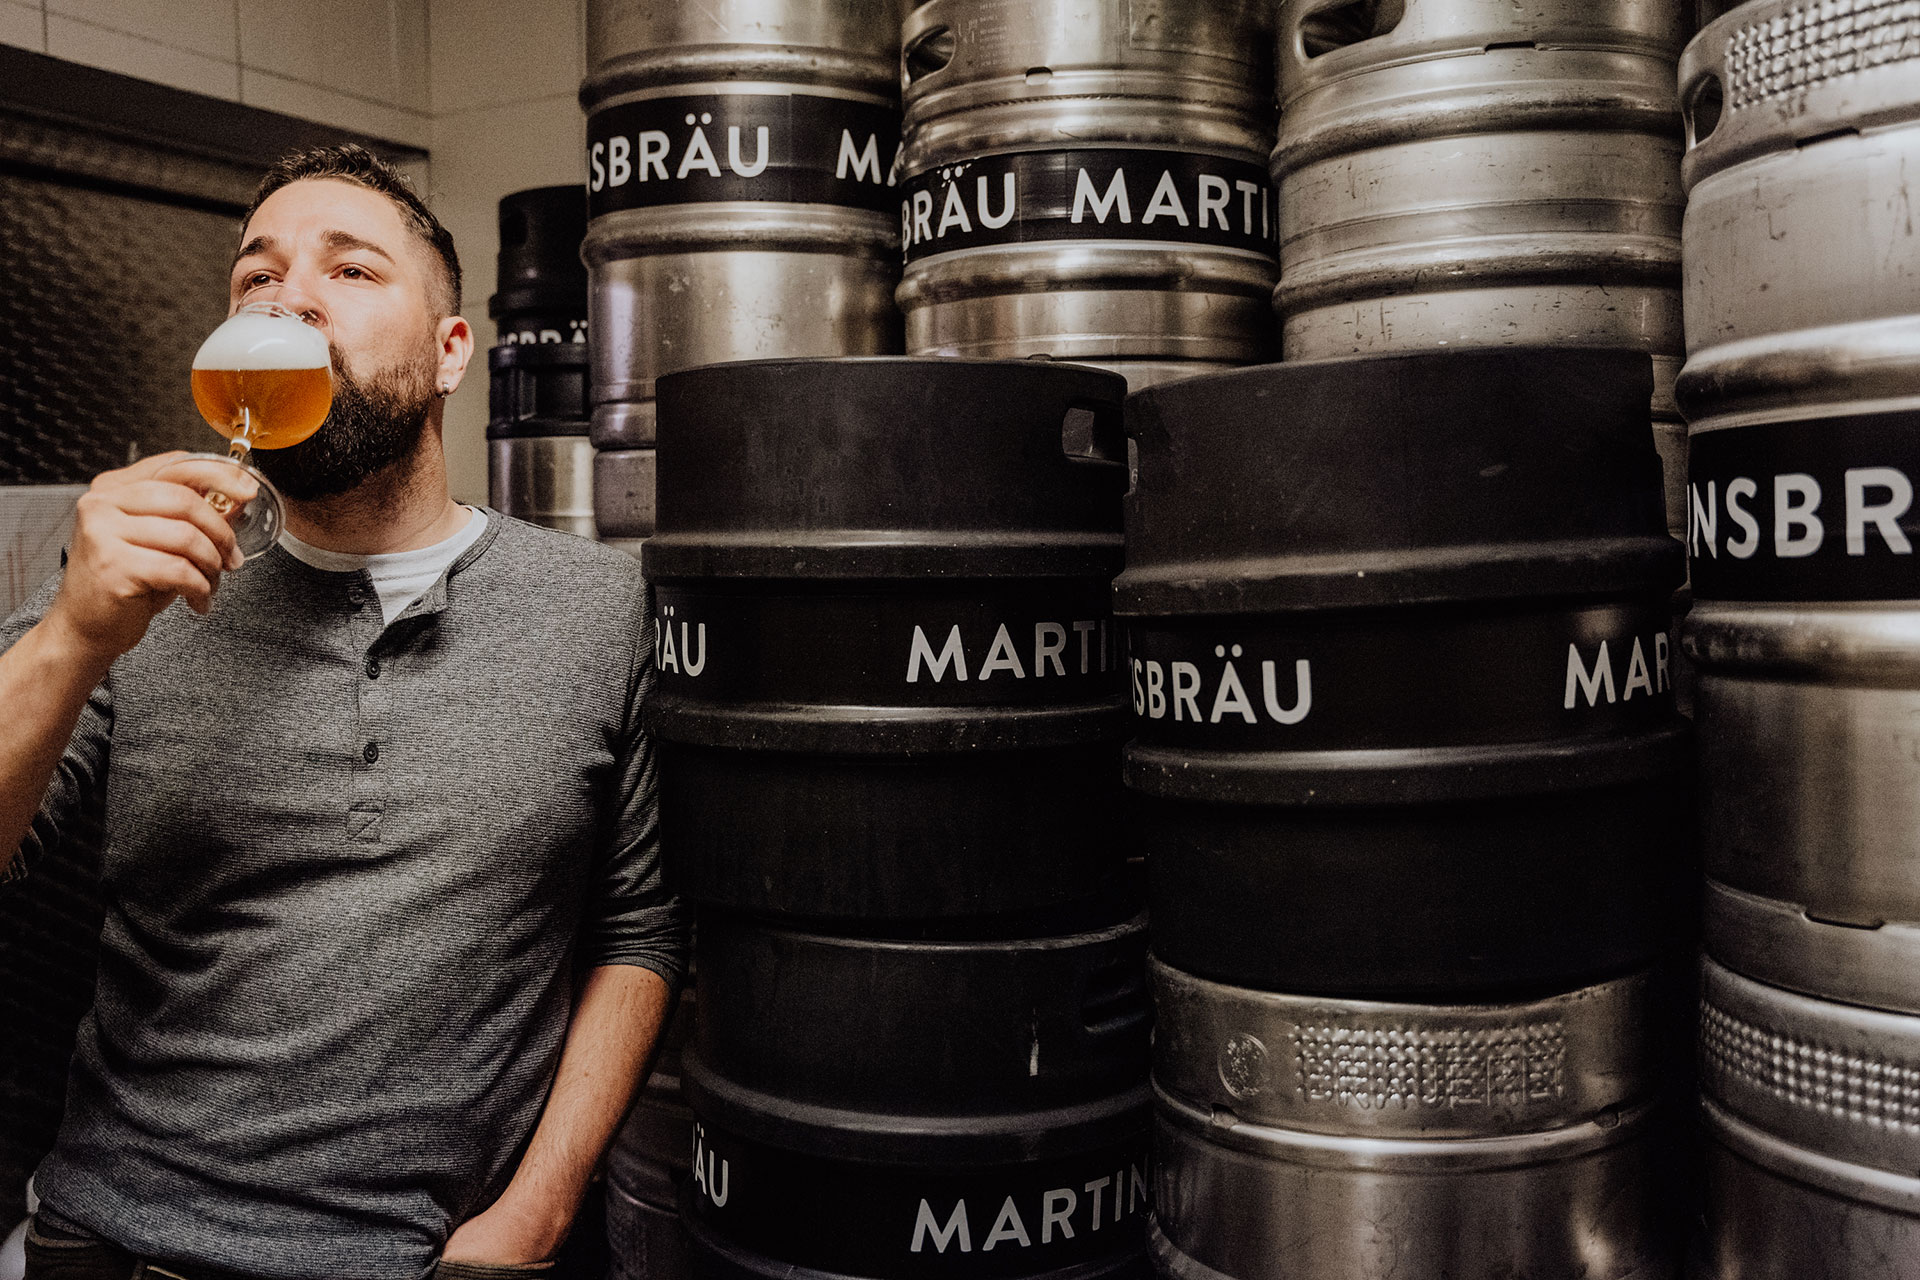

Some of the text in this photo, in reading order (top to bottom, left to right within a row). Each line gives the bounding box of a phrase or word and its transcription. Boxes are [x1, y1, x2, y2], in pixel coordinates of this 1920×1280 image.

[591, 112, 770, 193] SBRÄU
[1132, 644, 1313, 725] SBRÄU
[693, 1121, 729, 1208] ÄU
